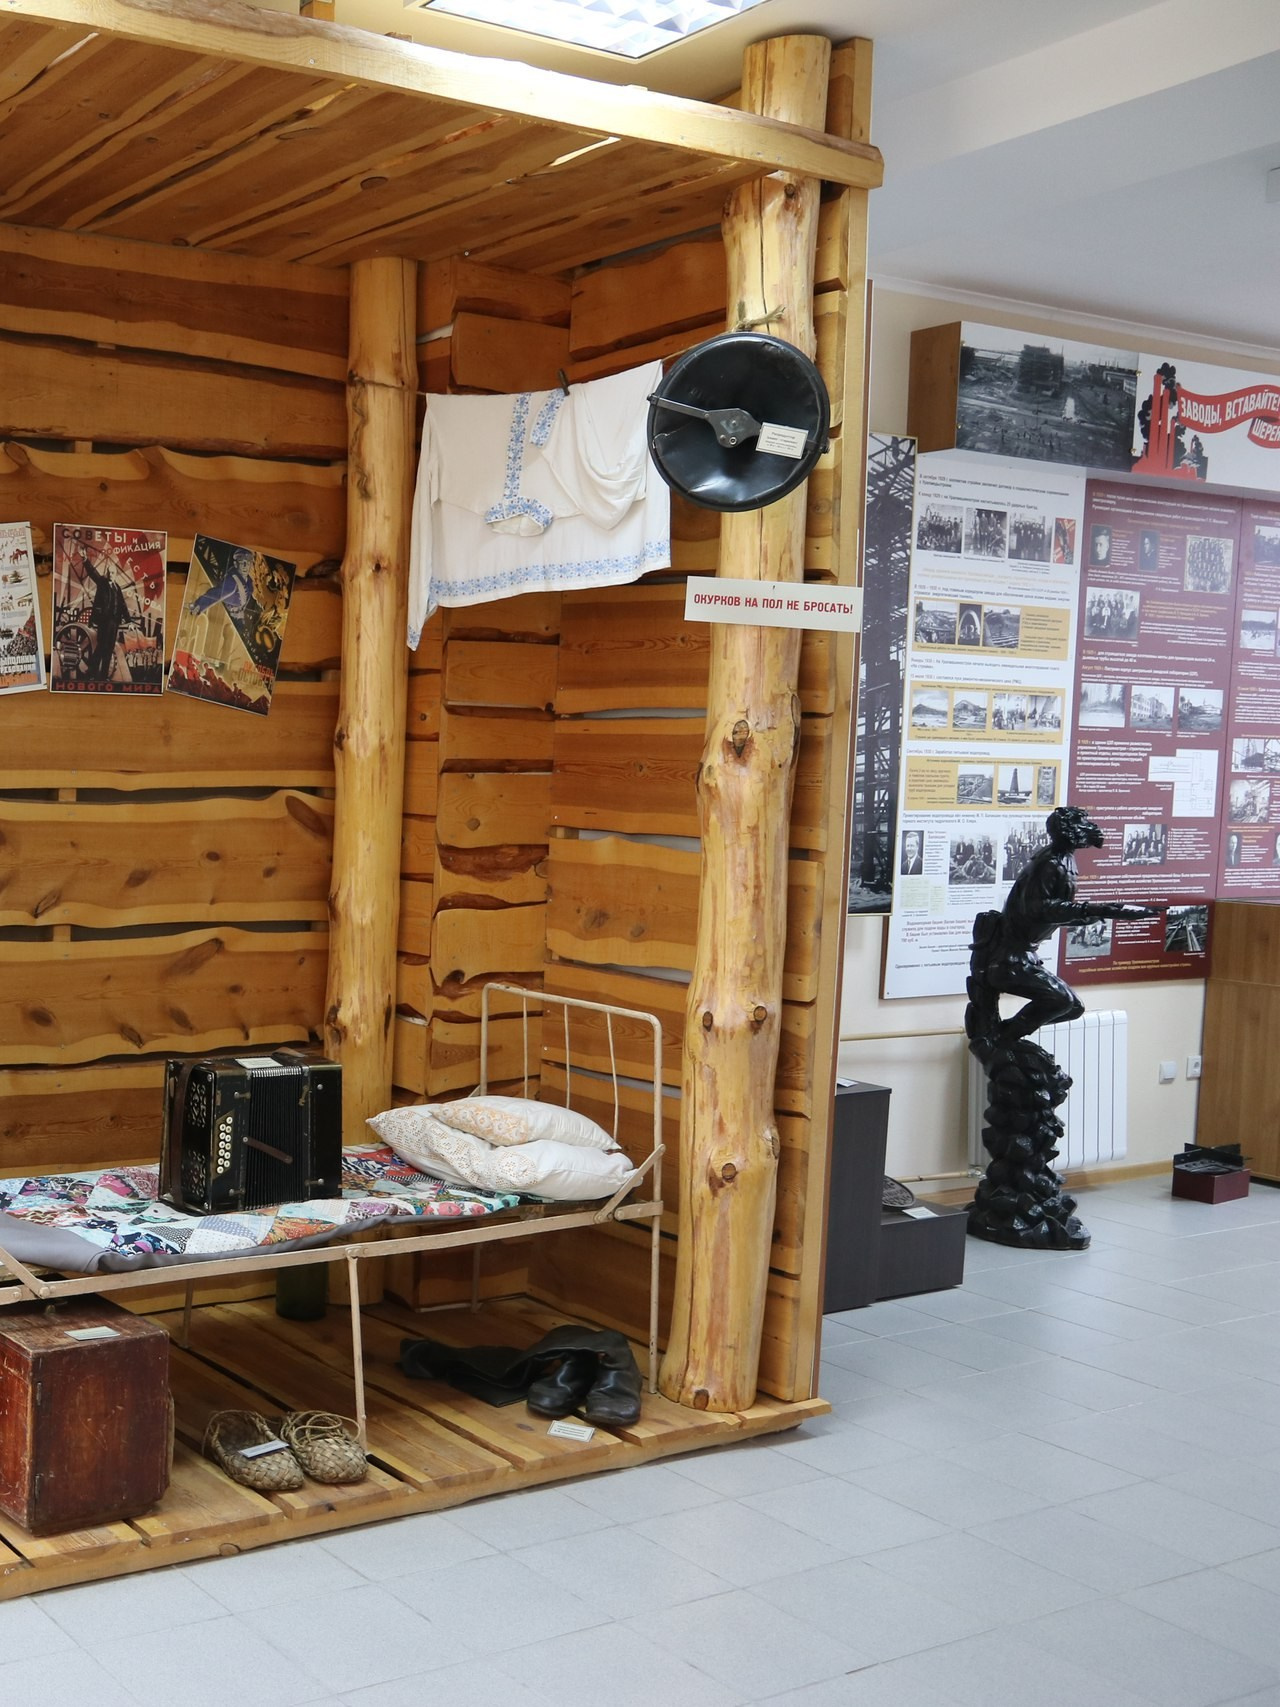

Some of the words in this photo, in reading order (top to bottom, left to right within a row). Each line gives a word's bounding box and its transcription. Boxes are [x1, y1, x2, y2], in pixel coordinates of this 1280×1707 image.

[1180, 396, 1222, 427] ЗАВОДЫ,
[1225, 389, 1280, 420] ВСТАВАЙТЕ!
[62, 528, 126, 544] СОВЕТЫ
[694, 594, 741, 606] ОКУРКОВ
[745, 598, 758, 607] НА
[762, 599, 783, 609] ПОЛ
[787, 601, 799, 610] НЕ
[804, 602, 853, 613] БРОСАТЬ!
[56, 682, 113, 692] НОВОГО
